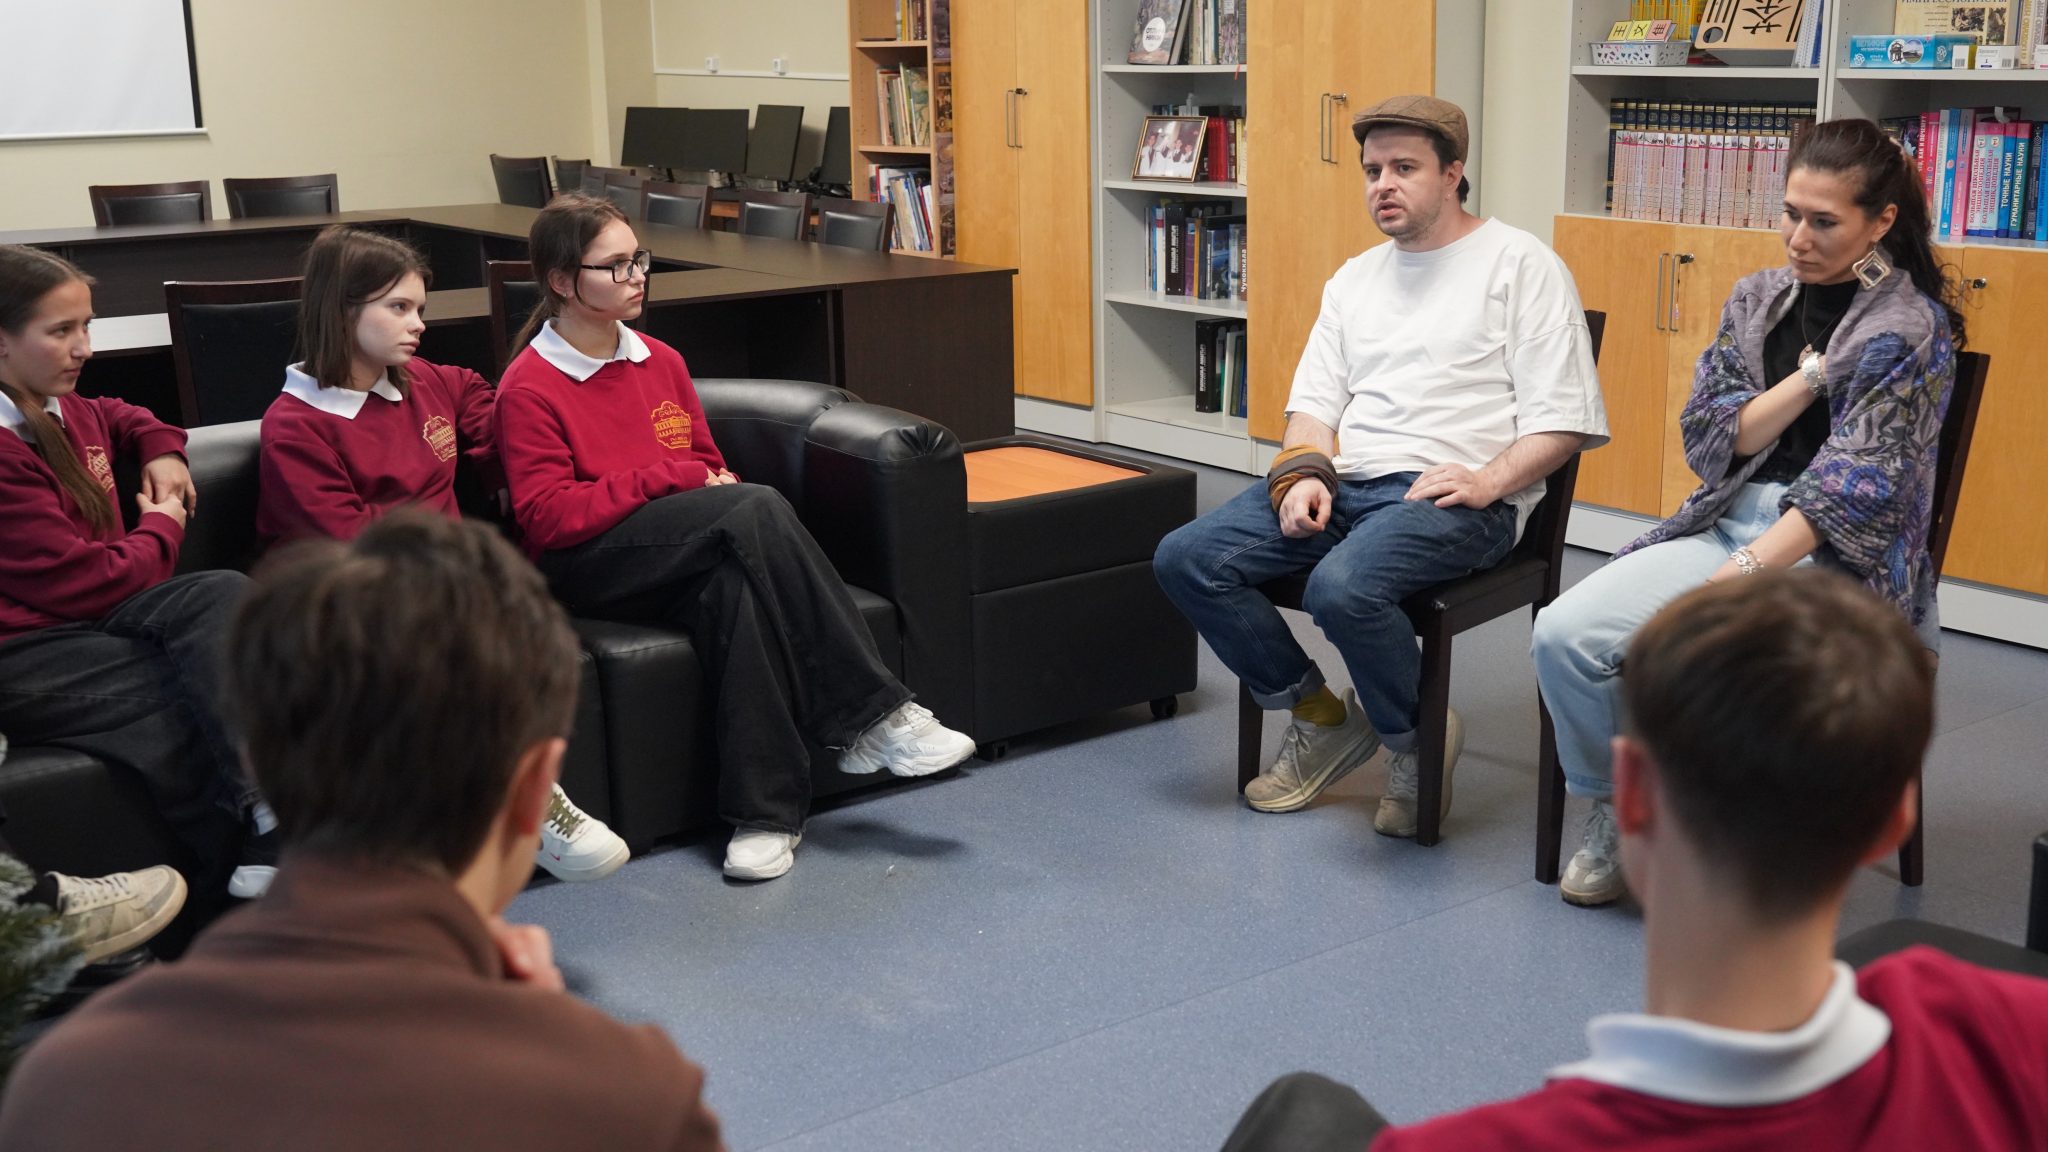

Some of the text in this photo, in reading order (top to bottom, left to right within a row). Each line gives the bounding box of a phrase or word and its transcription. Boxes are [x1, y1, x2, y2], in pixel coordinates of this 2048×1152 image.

[1972, 149, 1980, 187] ШКОЛЬНАЯ
[1976, 158, 1985, 212] ЭНЦИКЛОПЕДИЯ
[1982, 149, 1994, 224] БОЛЬШАЯ ШКОЛЬНАЯ
[1989, 158, 1999, 214] ЭНЦИКЛОПЕДИЯ
[2001, 152, 2013, 208] ТОЧНЫЕ НАУКИ
[2010, 142, 2025, 227] ГУМАНИТАРНЫЕ НАУКИ
